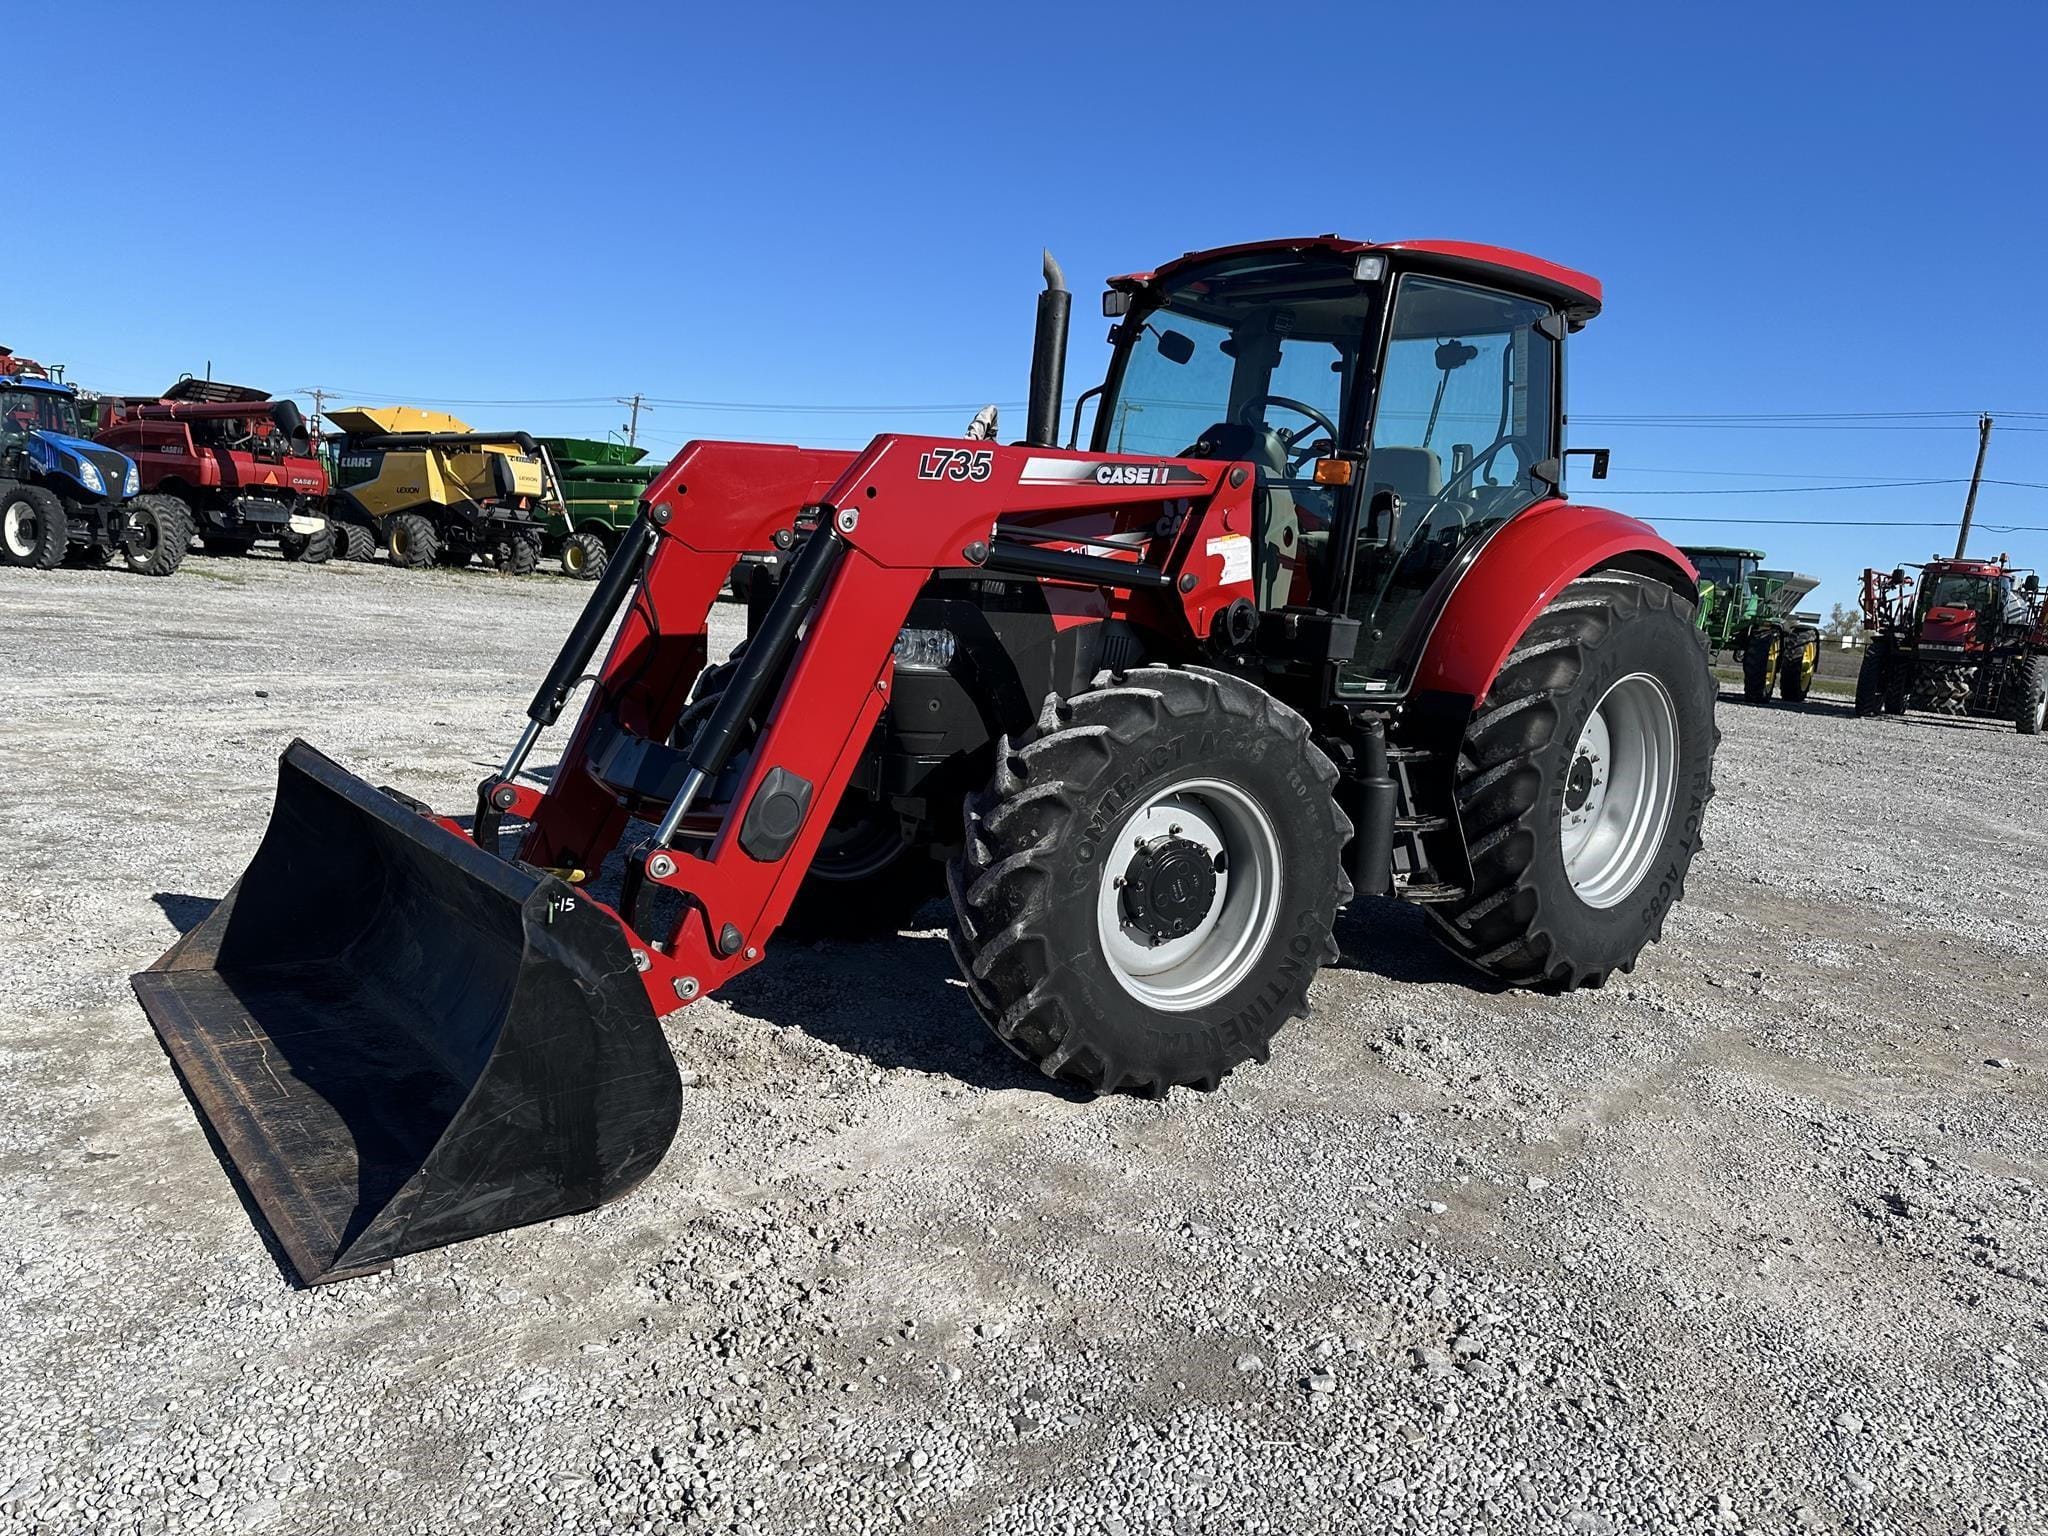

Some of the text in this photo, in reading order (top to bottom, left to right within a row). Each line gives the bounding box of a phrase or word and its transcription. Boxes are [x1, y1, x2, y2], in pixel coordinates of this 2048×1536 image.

[341, 457, 372, 467] CLAAS
[918, 448, 993, 482] L735
[1096, 465, 1151, 485] CASE
[396, 486, 420, 494] LEXION
[1069, 734, 1186, 889] CONTRACT
